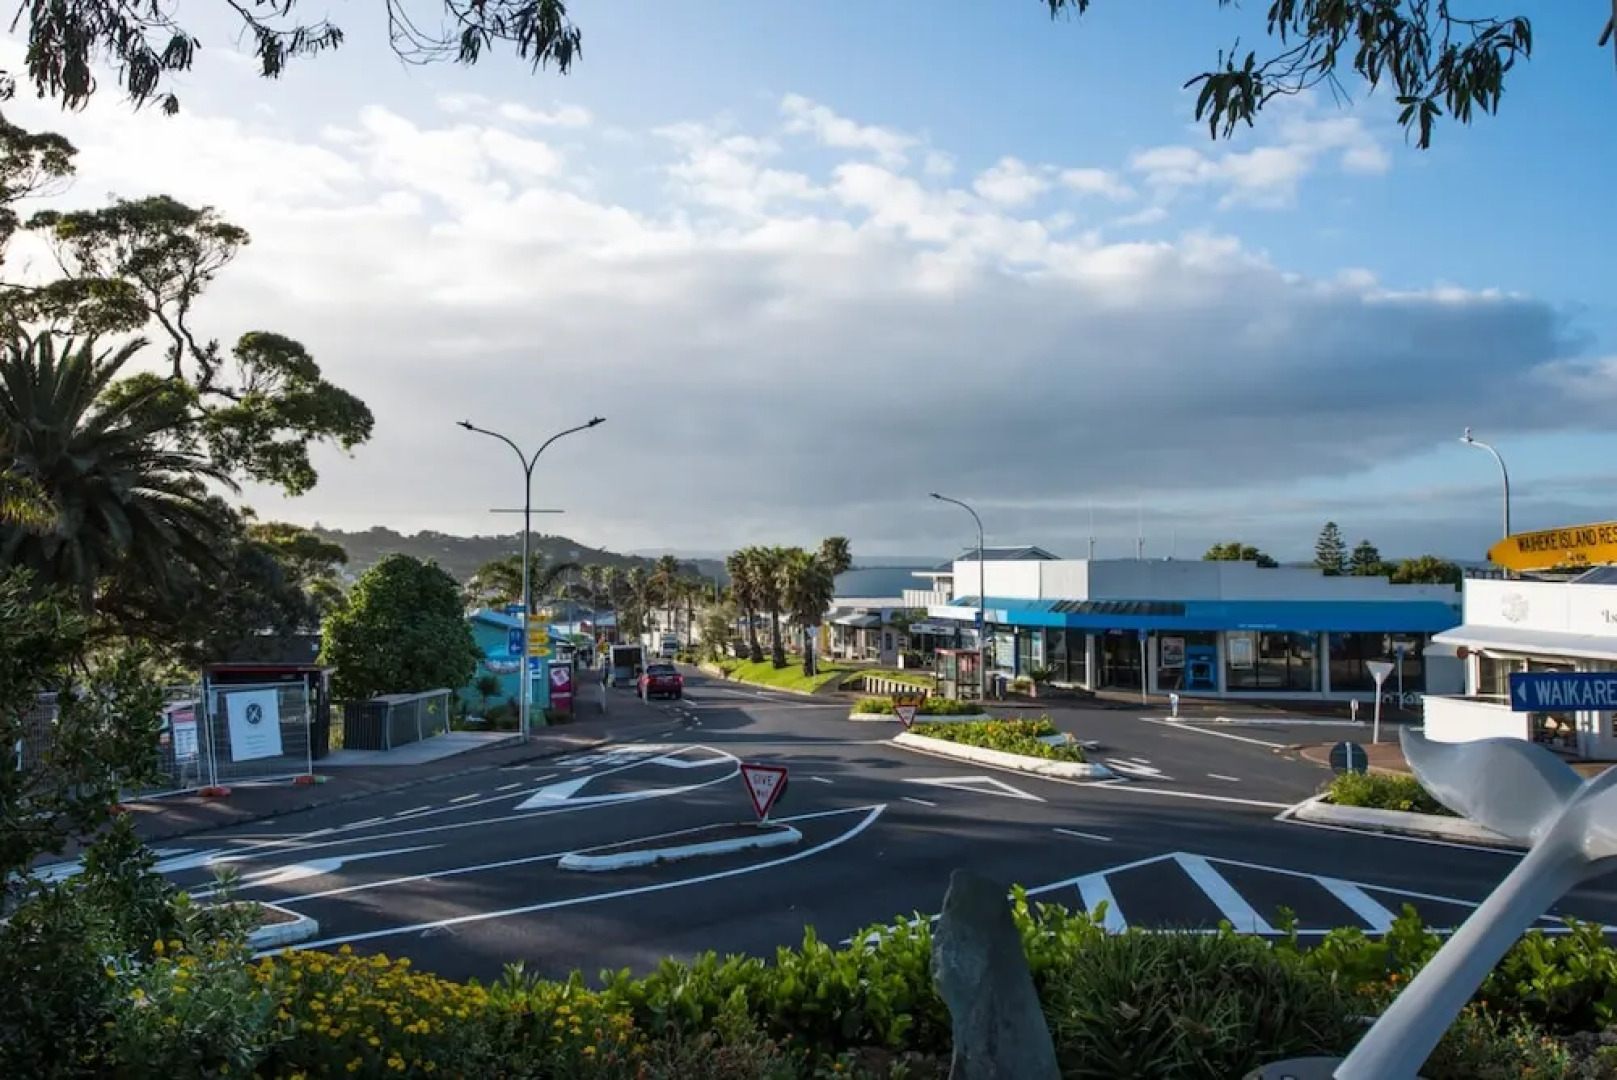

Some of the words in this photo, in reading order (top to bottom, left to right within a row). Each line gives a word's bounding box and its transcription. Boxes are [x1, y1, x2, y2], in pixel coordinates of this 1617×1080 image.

[1517, 533, 1557, 552] WAIHEKE
[1559, 529, 1596, 549] ISLAND
[1534, 679, 1617, 706] WAIKARE
